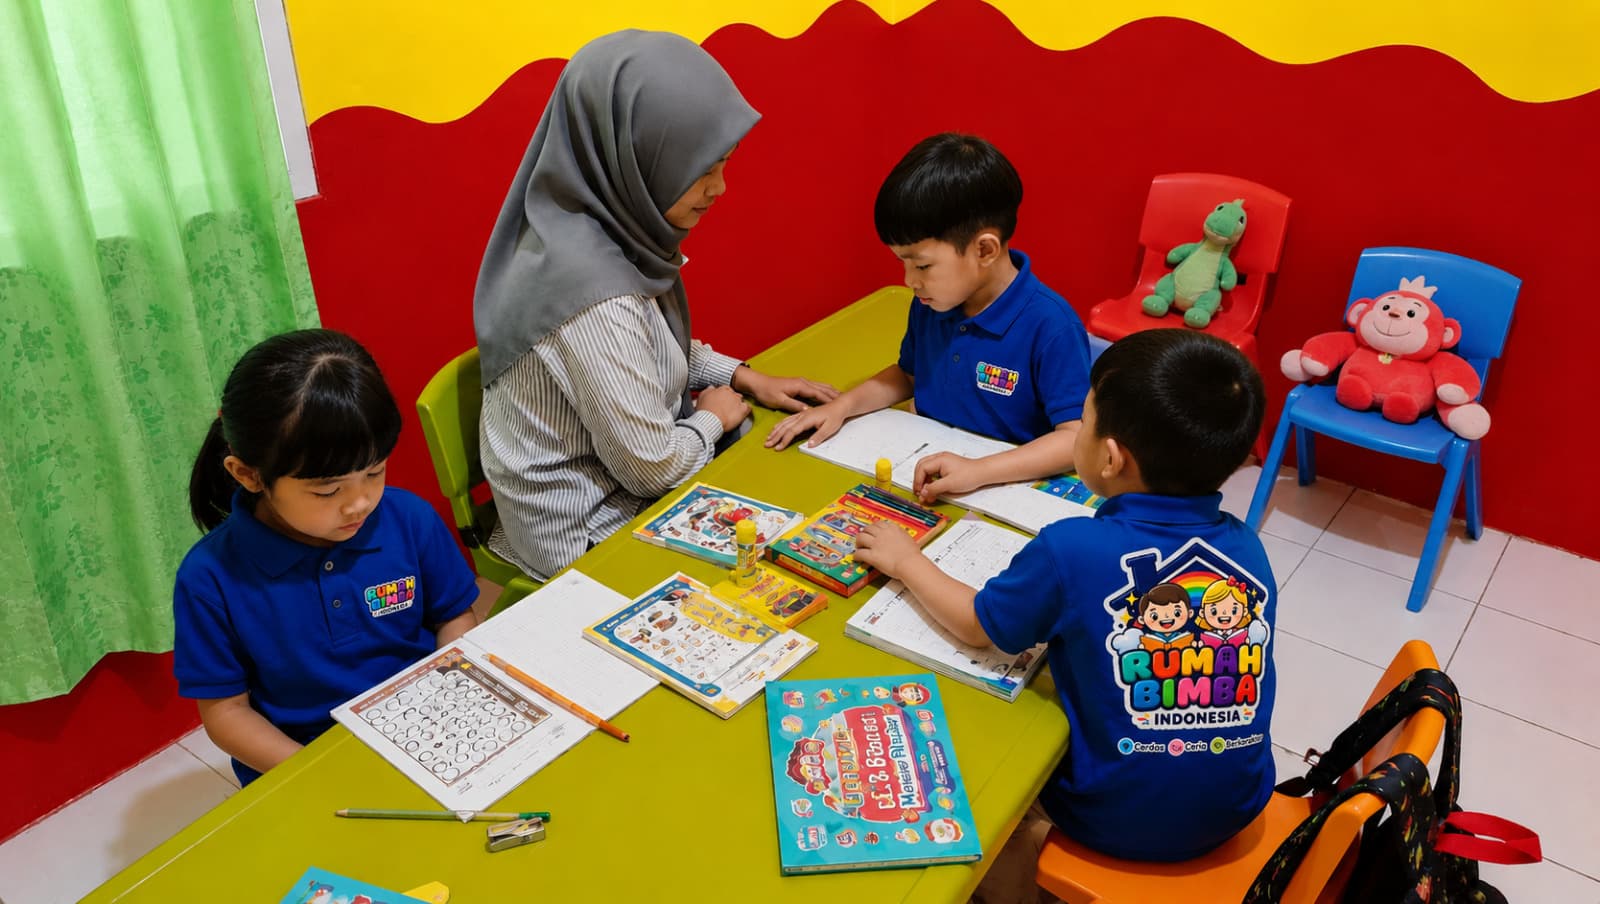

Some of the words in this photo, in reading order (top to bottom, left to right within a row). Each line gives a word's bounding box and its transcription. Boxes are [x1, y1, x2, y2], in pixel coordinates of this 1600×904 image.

[977, 362, 1018, 384] RUMAH
[366, 577, 415, 601] RUMAH
[1121, 644, 1262, 683] RUMAH
[1132, 675, 1258, 710] BIMBA
[1154, 710, 1241, 726] INDONESIA
[1134, 743, 1165, 752] Cerdas
[1185, 741, 1207, 752] Ceria
